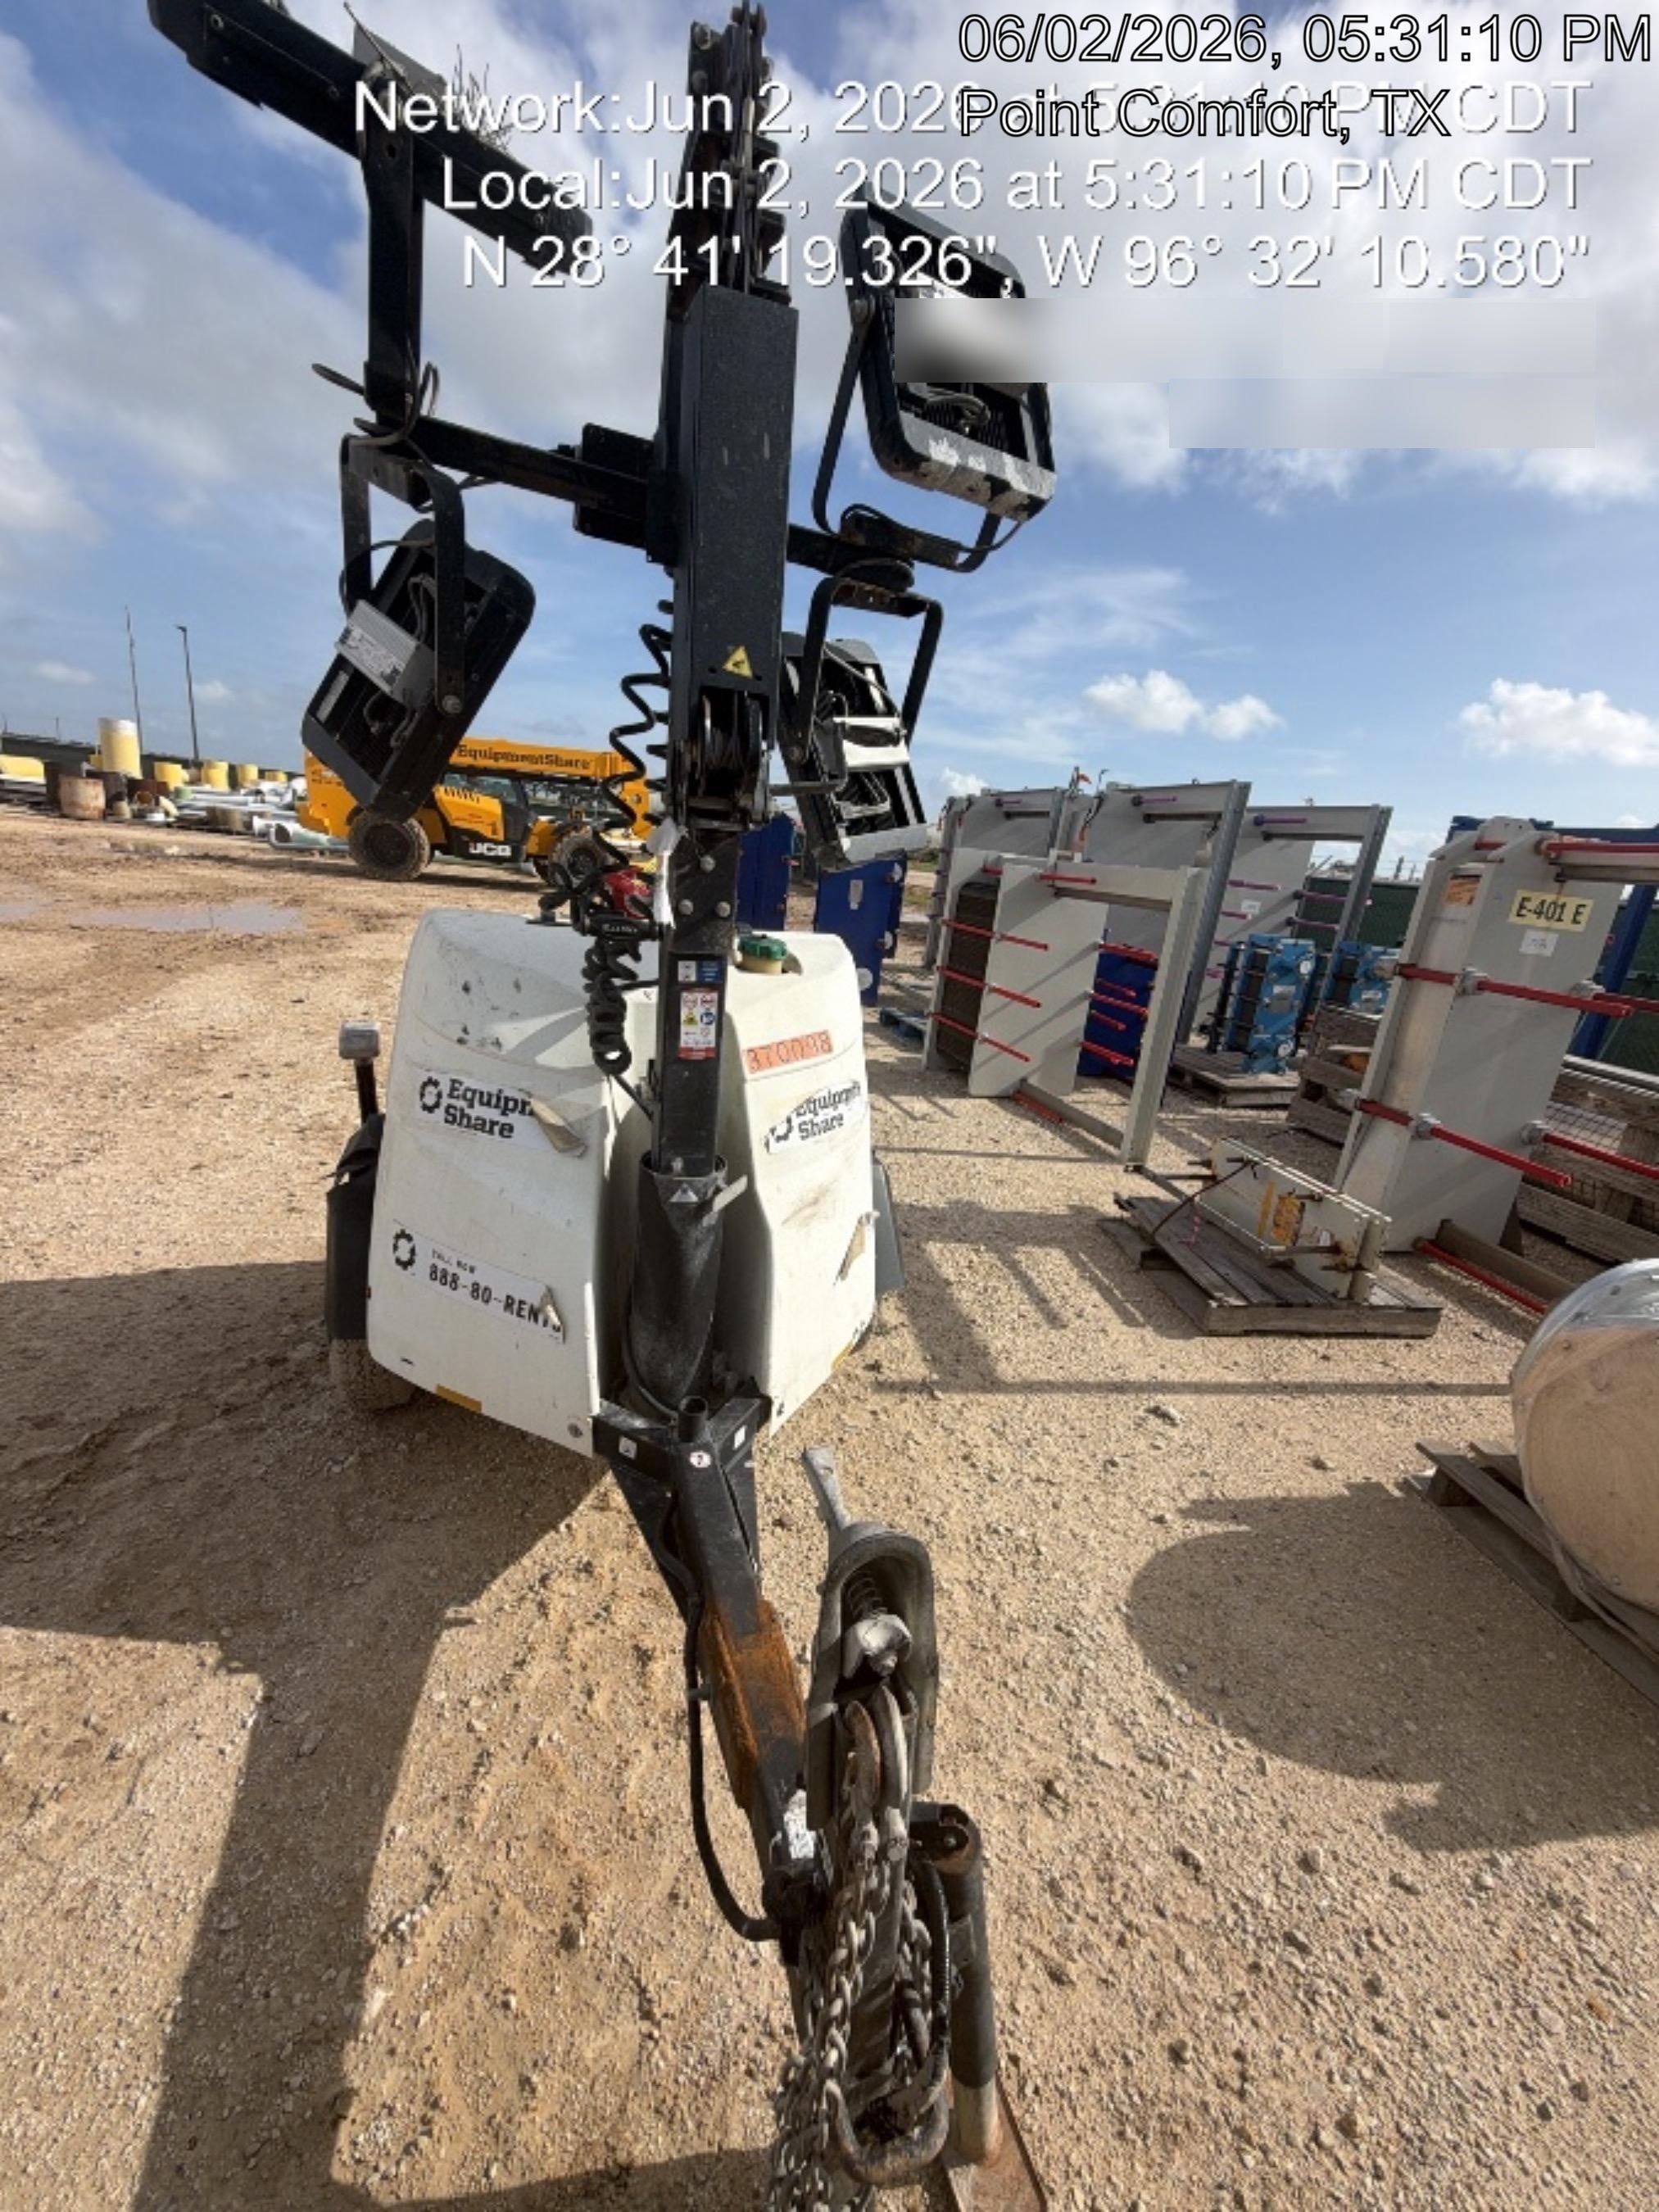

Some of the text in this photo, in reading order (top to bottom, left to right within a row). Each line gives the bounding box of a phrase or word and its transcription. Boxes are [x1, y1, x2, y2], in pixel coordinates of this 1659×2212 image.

[469, 842, 511, 856] JCB
[1515, 896, 1587, 925] E-401 E
[443, 1103, 514, 1139] Share
[797, 1113, 845, 1140] Share
